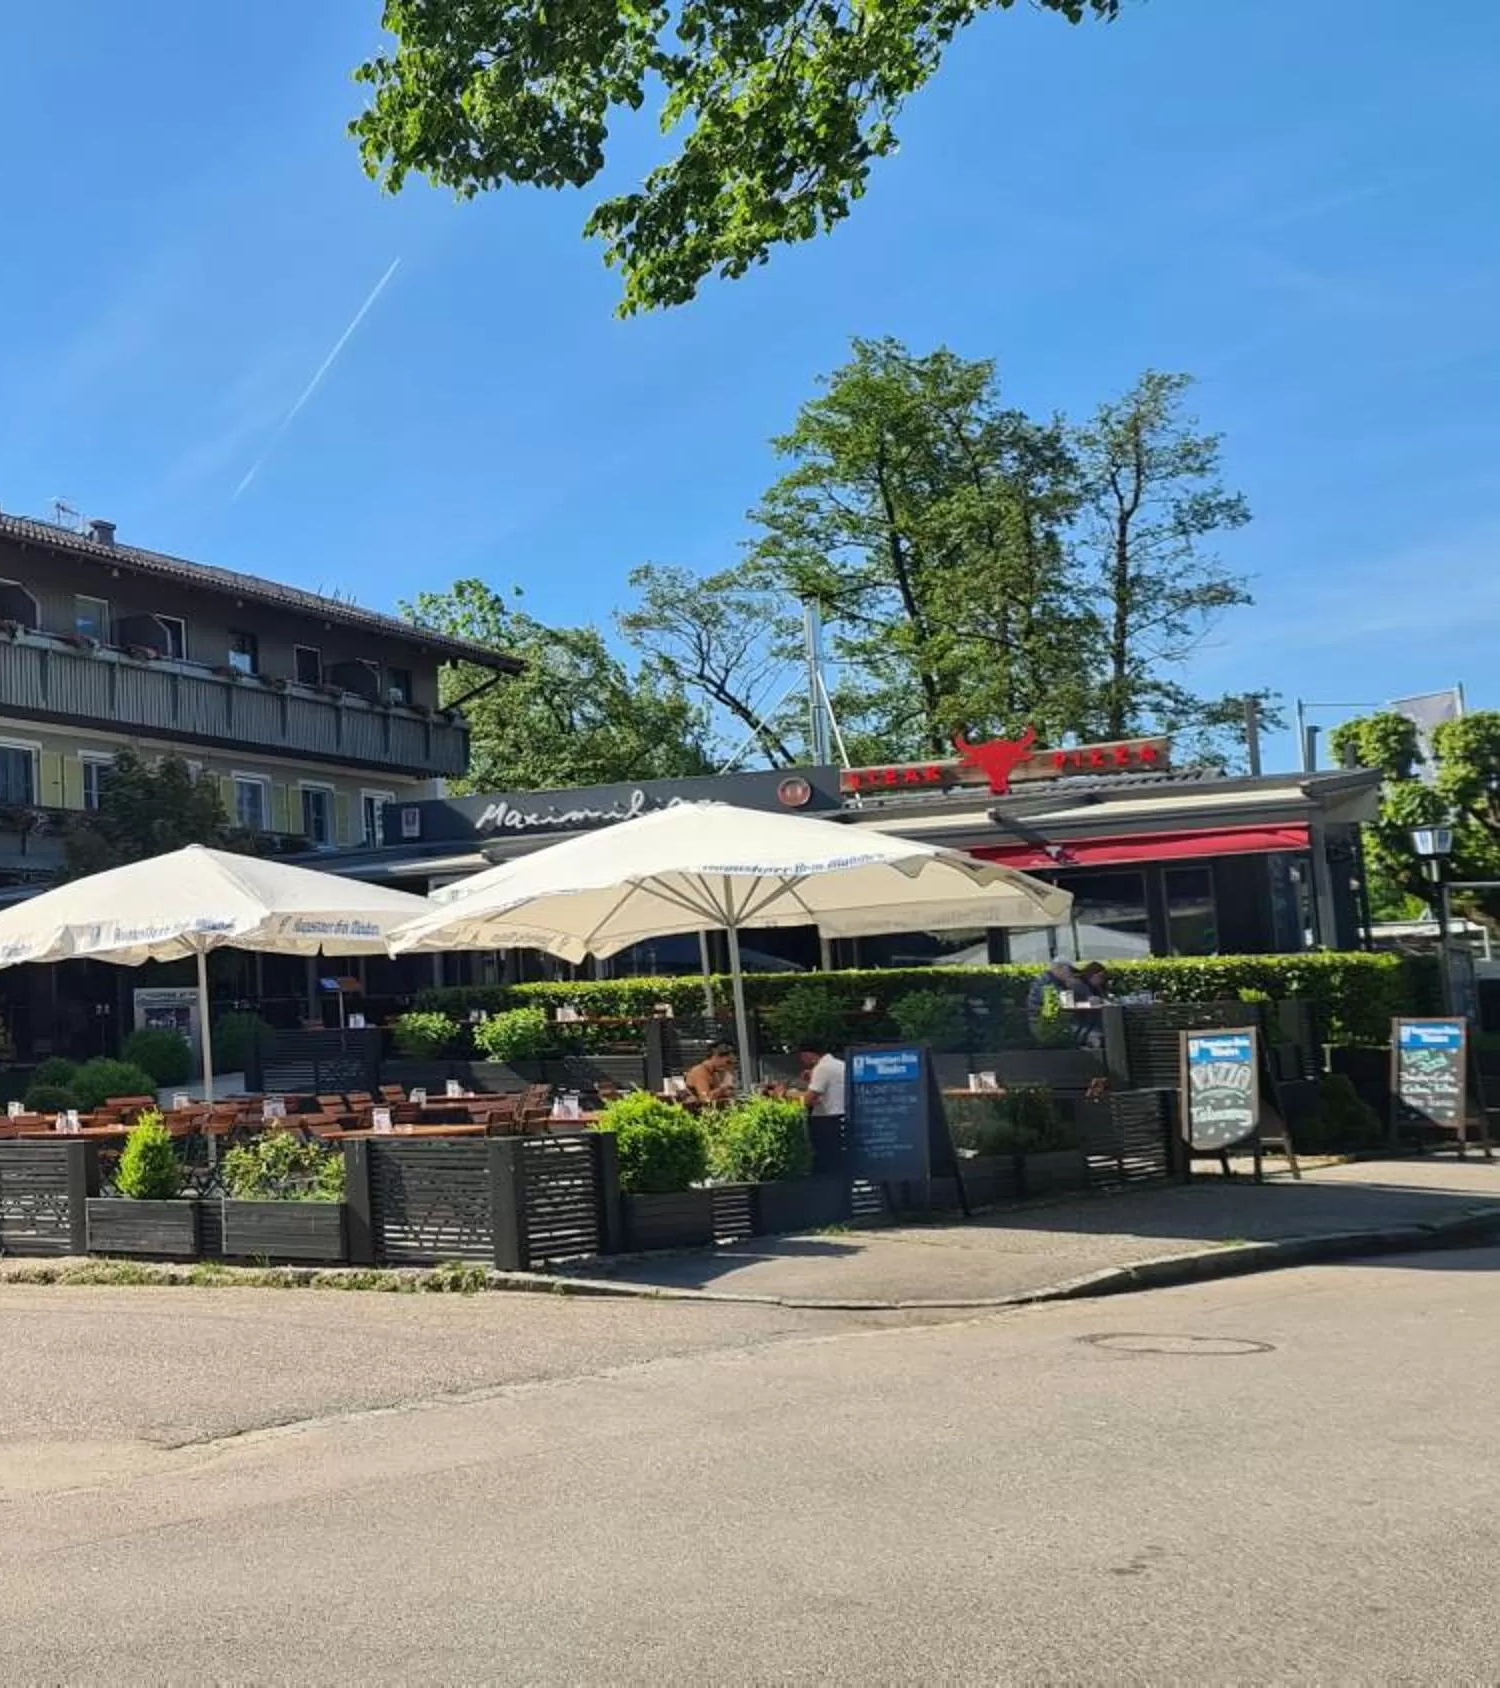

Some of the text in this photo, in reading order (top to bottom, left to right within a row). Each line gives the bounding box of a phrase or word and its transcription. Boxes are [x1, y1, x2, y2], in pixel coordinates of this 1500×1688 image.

[1053, 745, 1157, 769] PIZZA
[850, 765, 941, 790] STEAK
[474, 789, 712, 831] Maximili
